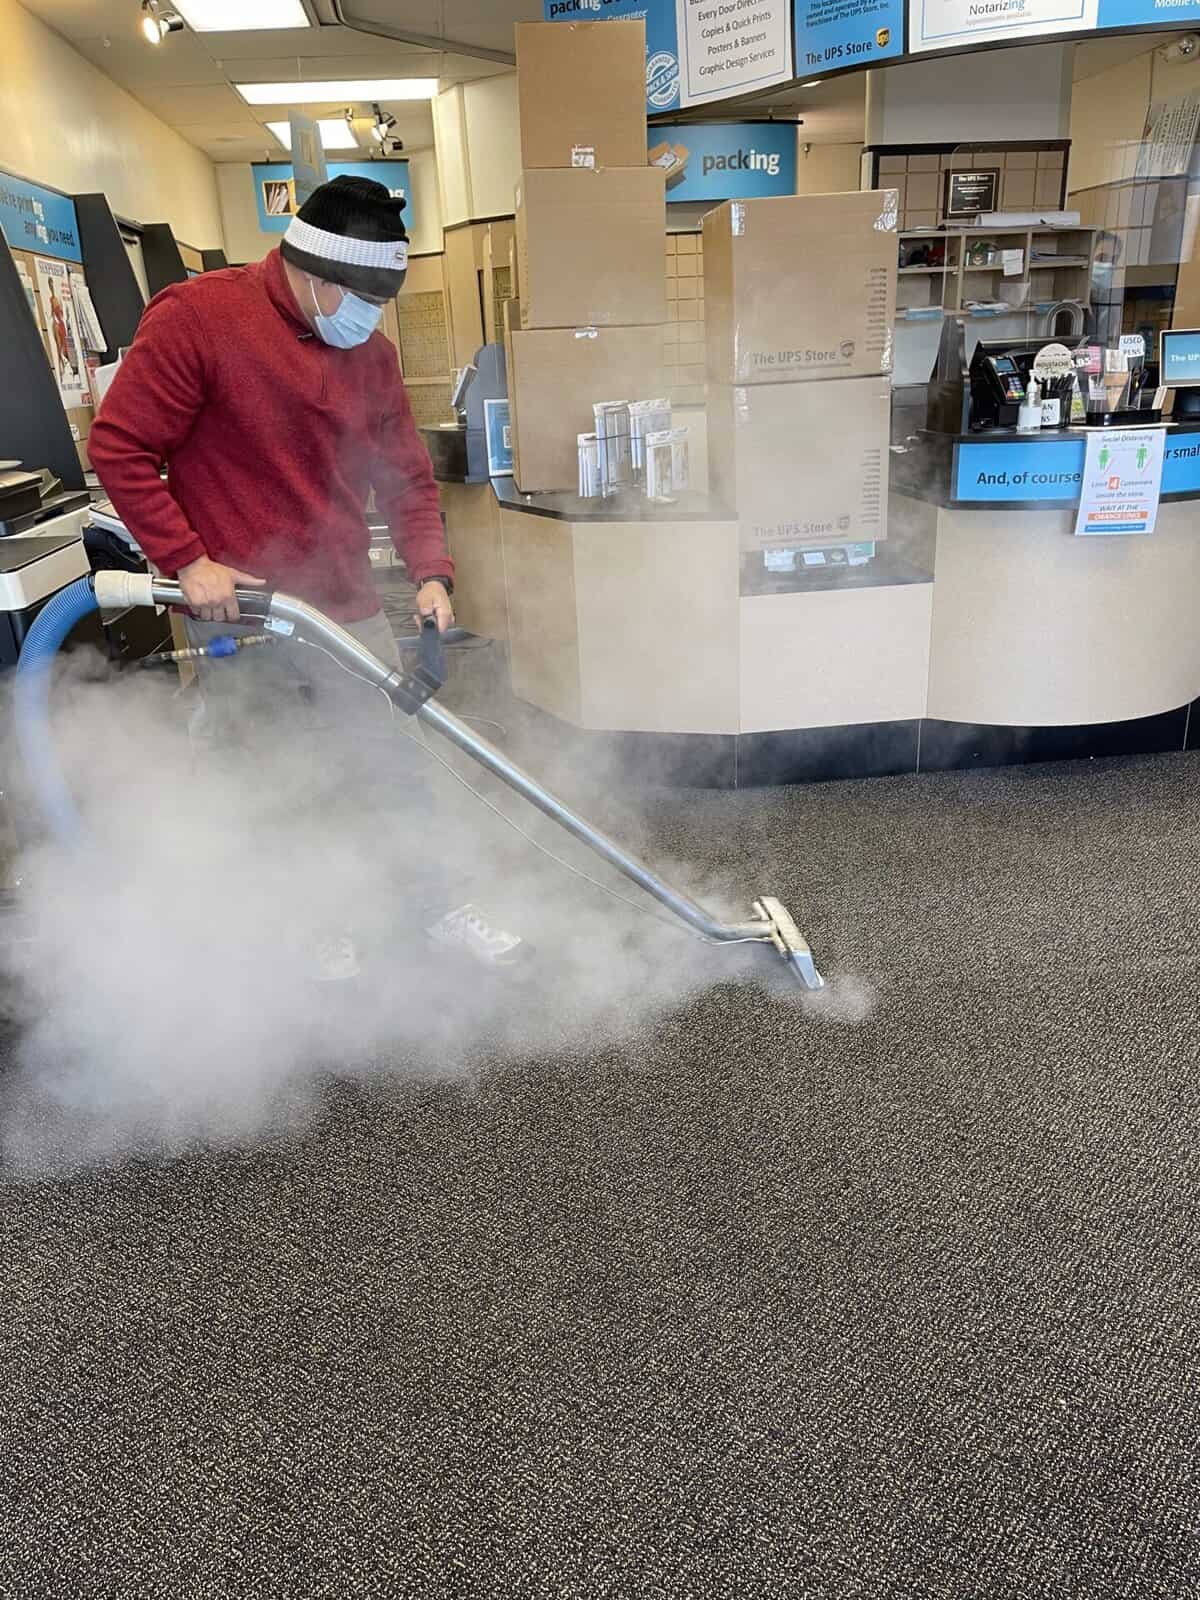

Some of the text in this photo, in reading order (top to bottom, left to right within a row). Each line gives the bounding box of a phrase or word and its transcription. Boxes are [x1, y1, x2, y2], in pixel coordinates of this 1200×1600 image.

[697, 11, 717, 21] Every
[718, 4, 736, 16] Door
[969, 0, 1025, 15] Notarizing
[701, 11, 771, 39] Copies & Quick Prints
[707, 32, 767, 55] Posters & Banners
[806, 41, 872, 65] The UPS Store
[699, 48, 775, 76] Graphic Design Services
[703, 150, 780, 176] packing
[1123, 336, 1142, 345] USED
[752, 348, 837, 365] The UPS Store
[1187, 353, 1200, 362] UP
[1173, 443, 1200, 459] smal
[976, 471, 1010, 487] And,
[1012, 471, 1027, 485] of
